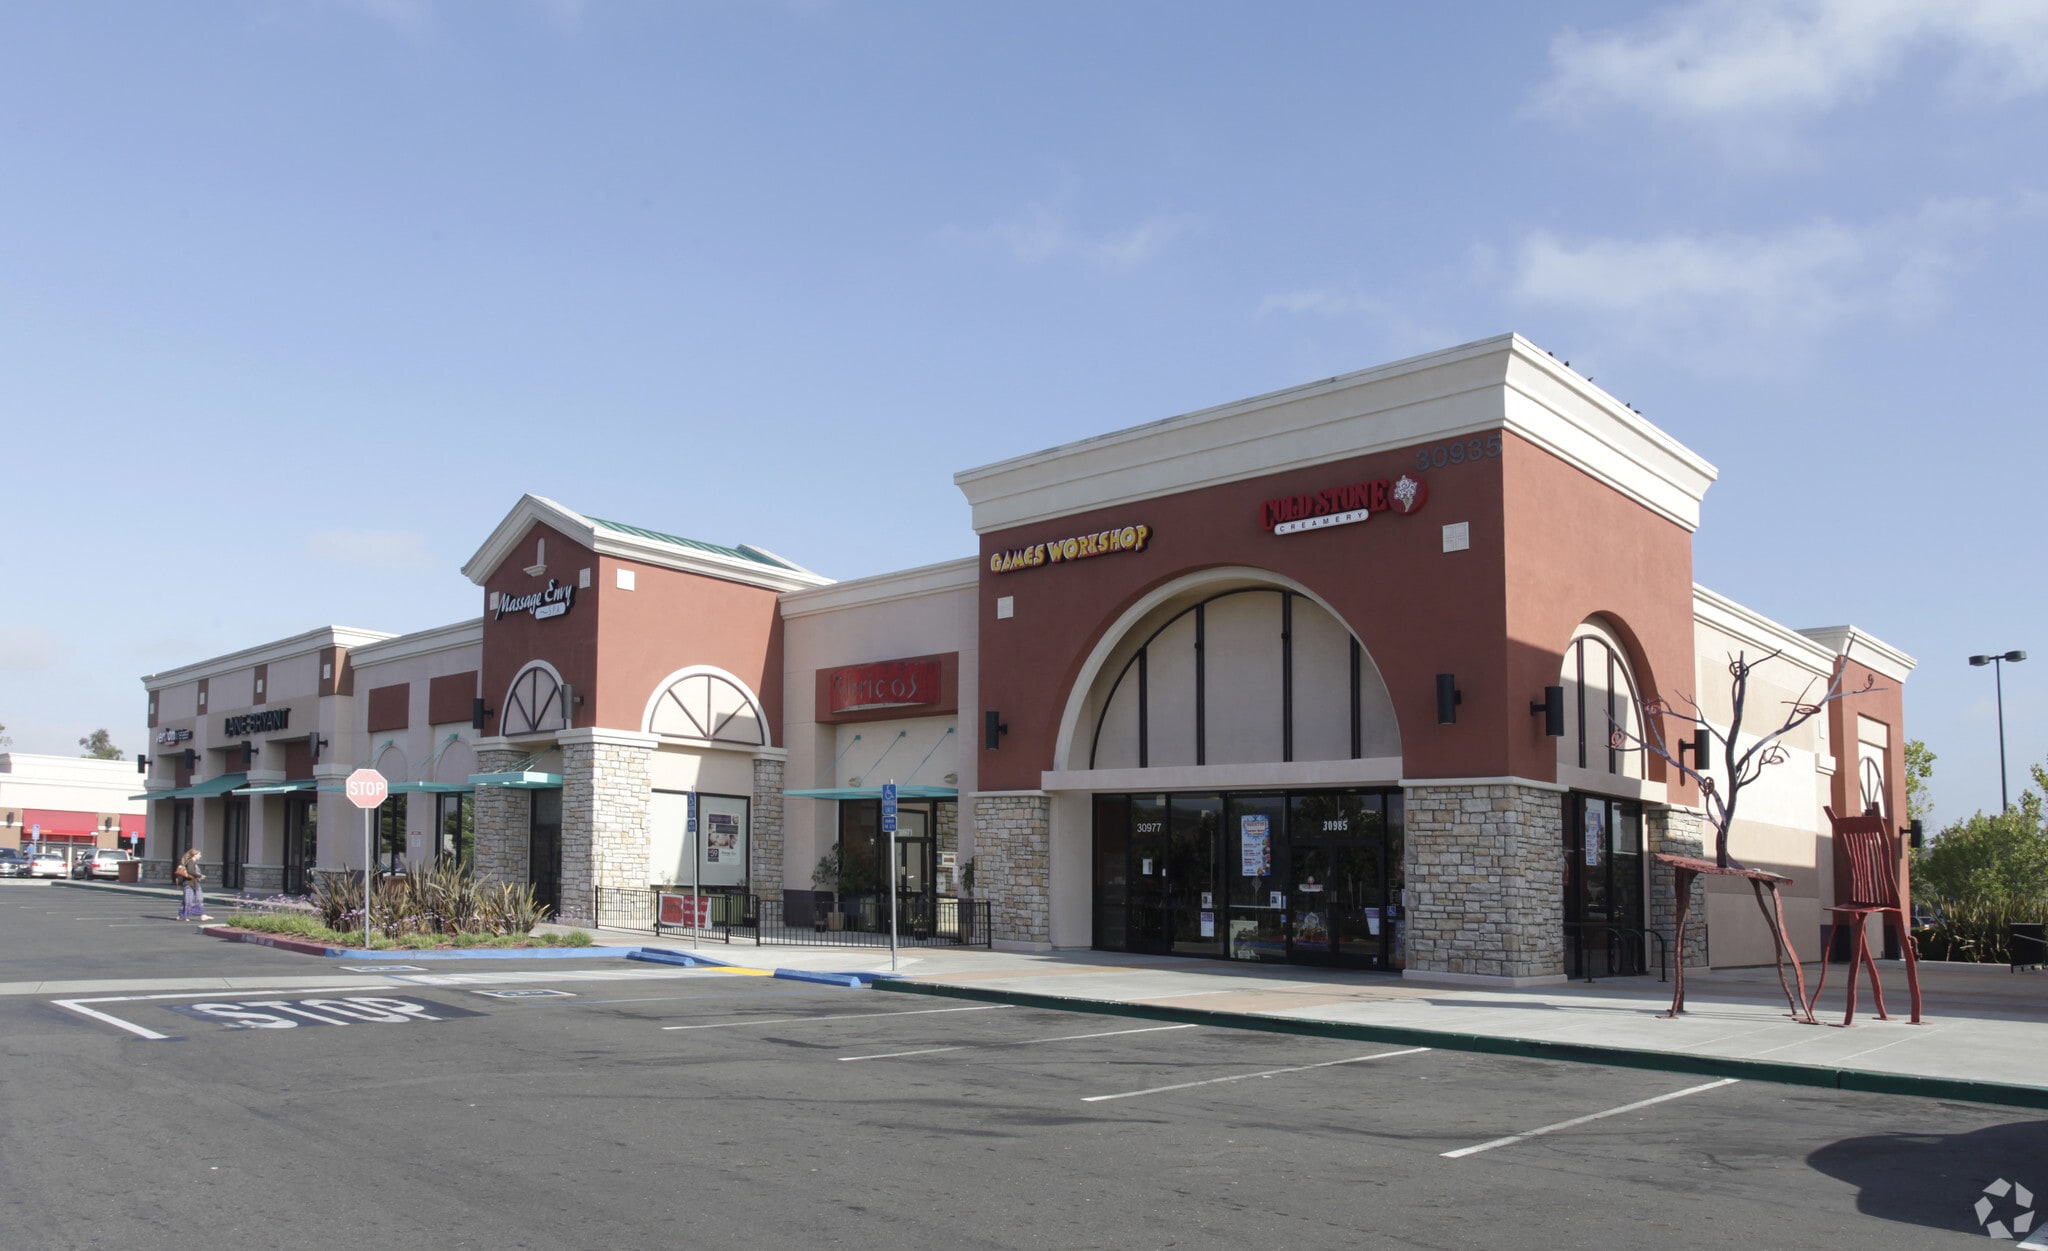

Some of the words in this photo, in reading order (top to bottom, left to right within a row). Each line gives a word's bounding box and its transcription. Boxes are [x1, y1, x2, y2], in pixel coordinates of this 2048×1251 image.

[1415, 434, 1502, 472] 30935
[1260, 493, 1314, 531] COLD
[1315, 479, 1389, 515] STONE
[1279, 511, 1364, 532] CREAMERY
[991, 544, 1046, 572] GAMES
[1047, 524, 1149, 562] WORKSHOP
[495, 592, 542, 620] Massage
[545, 579, 573, 607] Envy
[225, 715, 249, 737] LANE
[250, 708, 291, 733] BRYANT
[350, 781, 385, 796] STOP
[1137, 823, 1161, 833] 30977
[1323, 820, 1348, 831] 30985
[192, 996, 443, 1030] STOP
